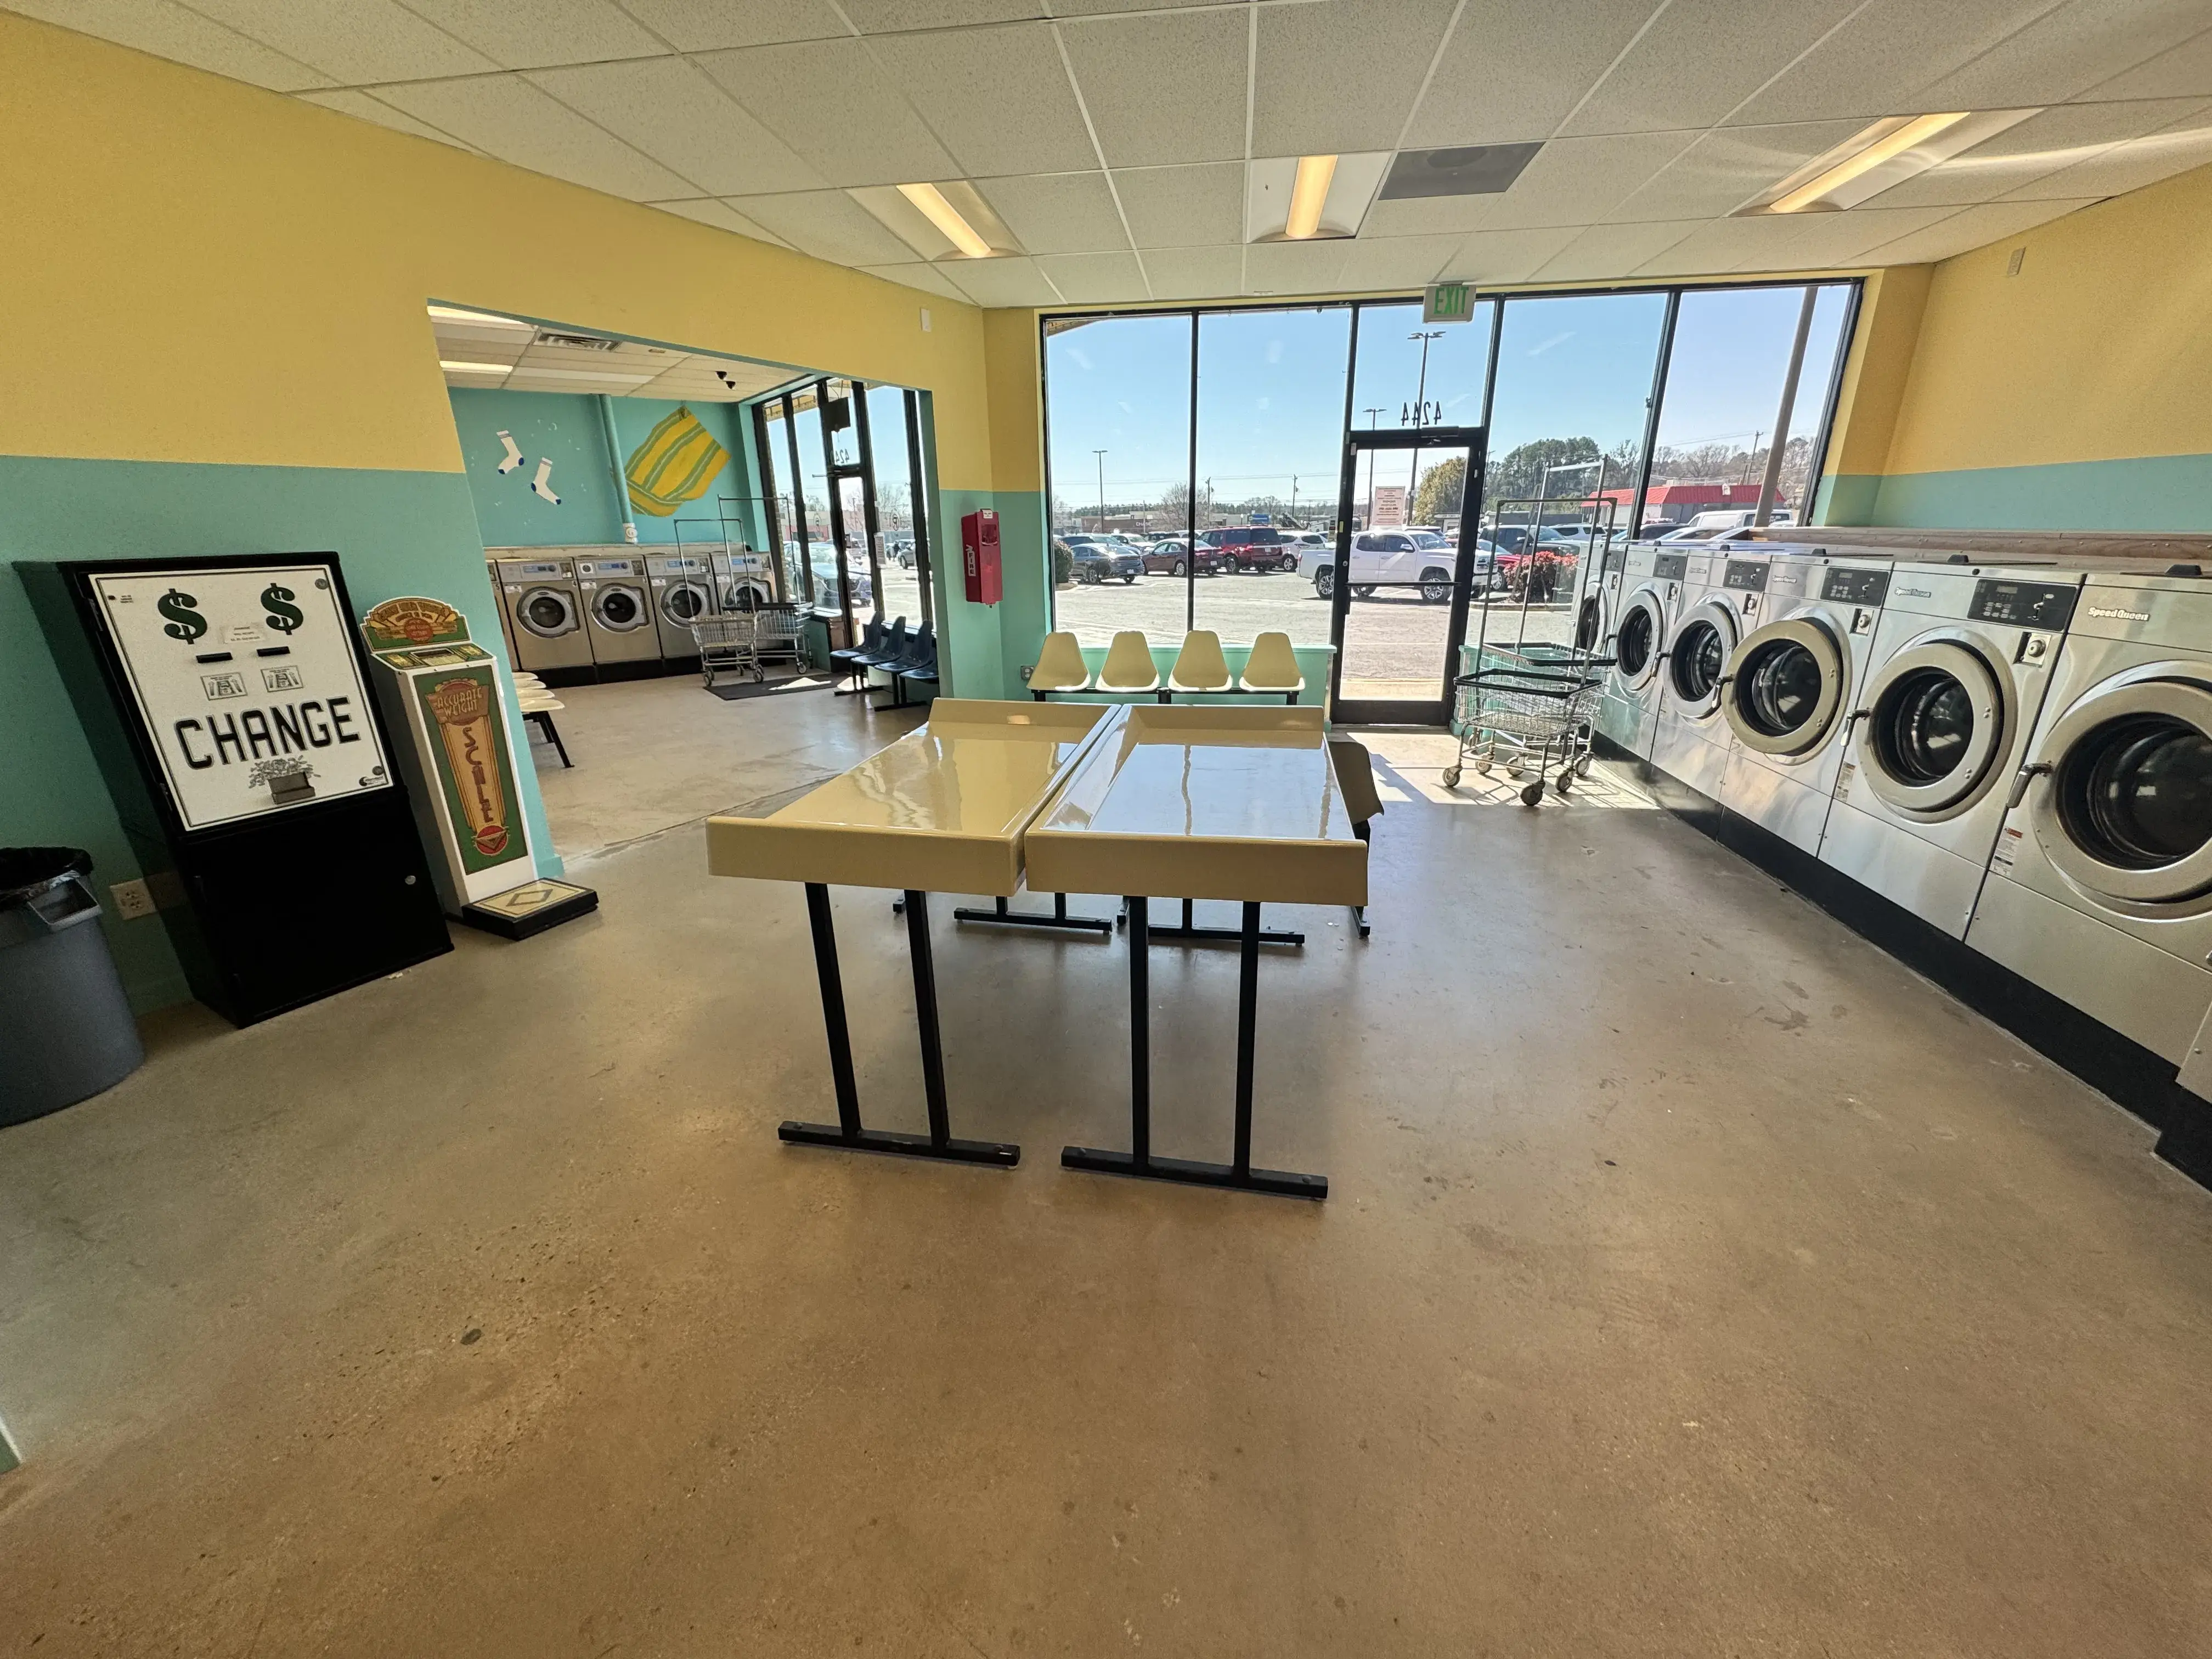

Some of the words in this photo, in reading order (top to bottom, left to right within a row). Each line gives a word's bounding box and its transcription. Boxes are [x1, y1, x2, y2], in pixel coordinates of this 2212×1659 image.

[1433, 286, 1469, 315] EXIT
[157, 588, 208, 645] $
[261, 583, 304, 635] $
[2087, 606, 2118, 618] Speed
[2117, 609, 2149, 621] Queen
[437, 686, 483, 709] ACCURATE
[443, 698, 478, 716] WEIGHT
[174, 695, 362, 770] CHANGE
[461, 726, 494, 823] SCALE
